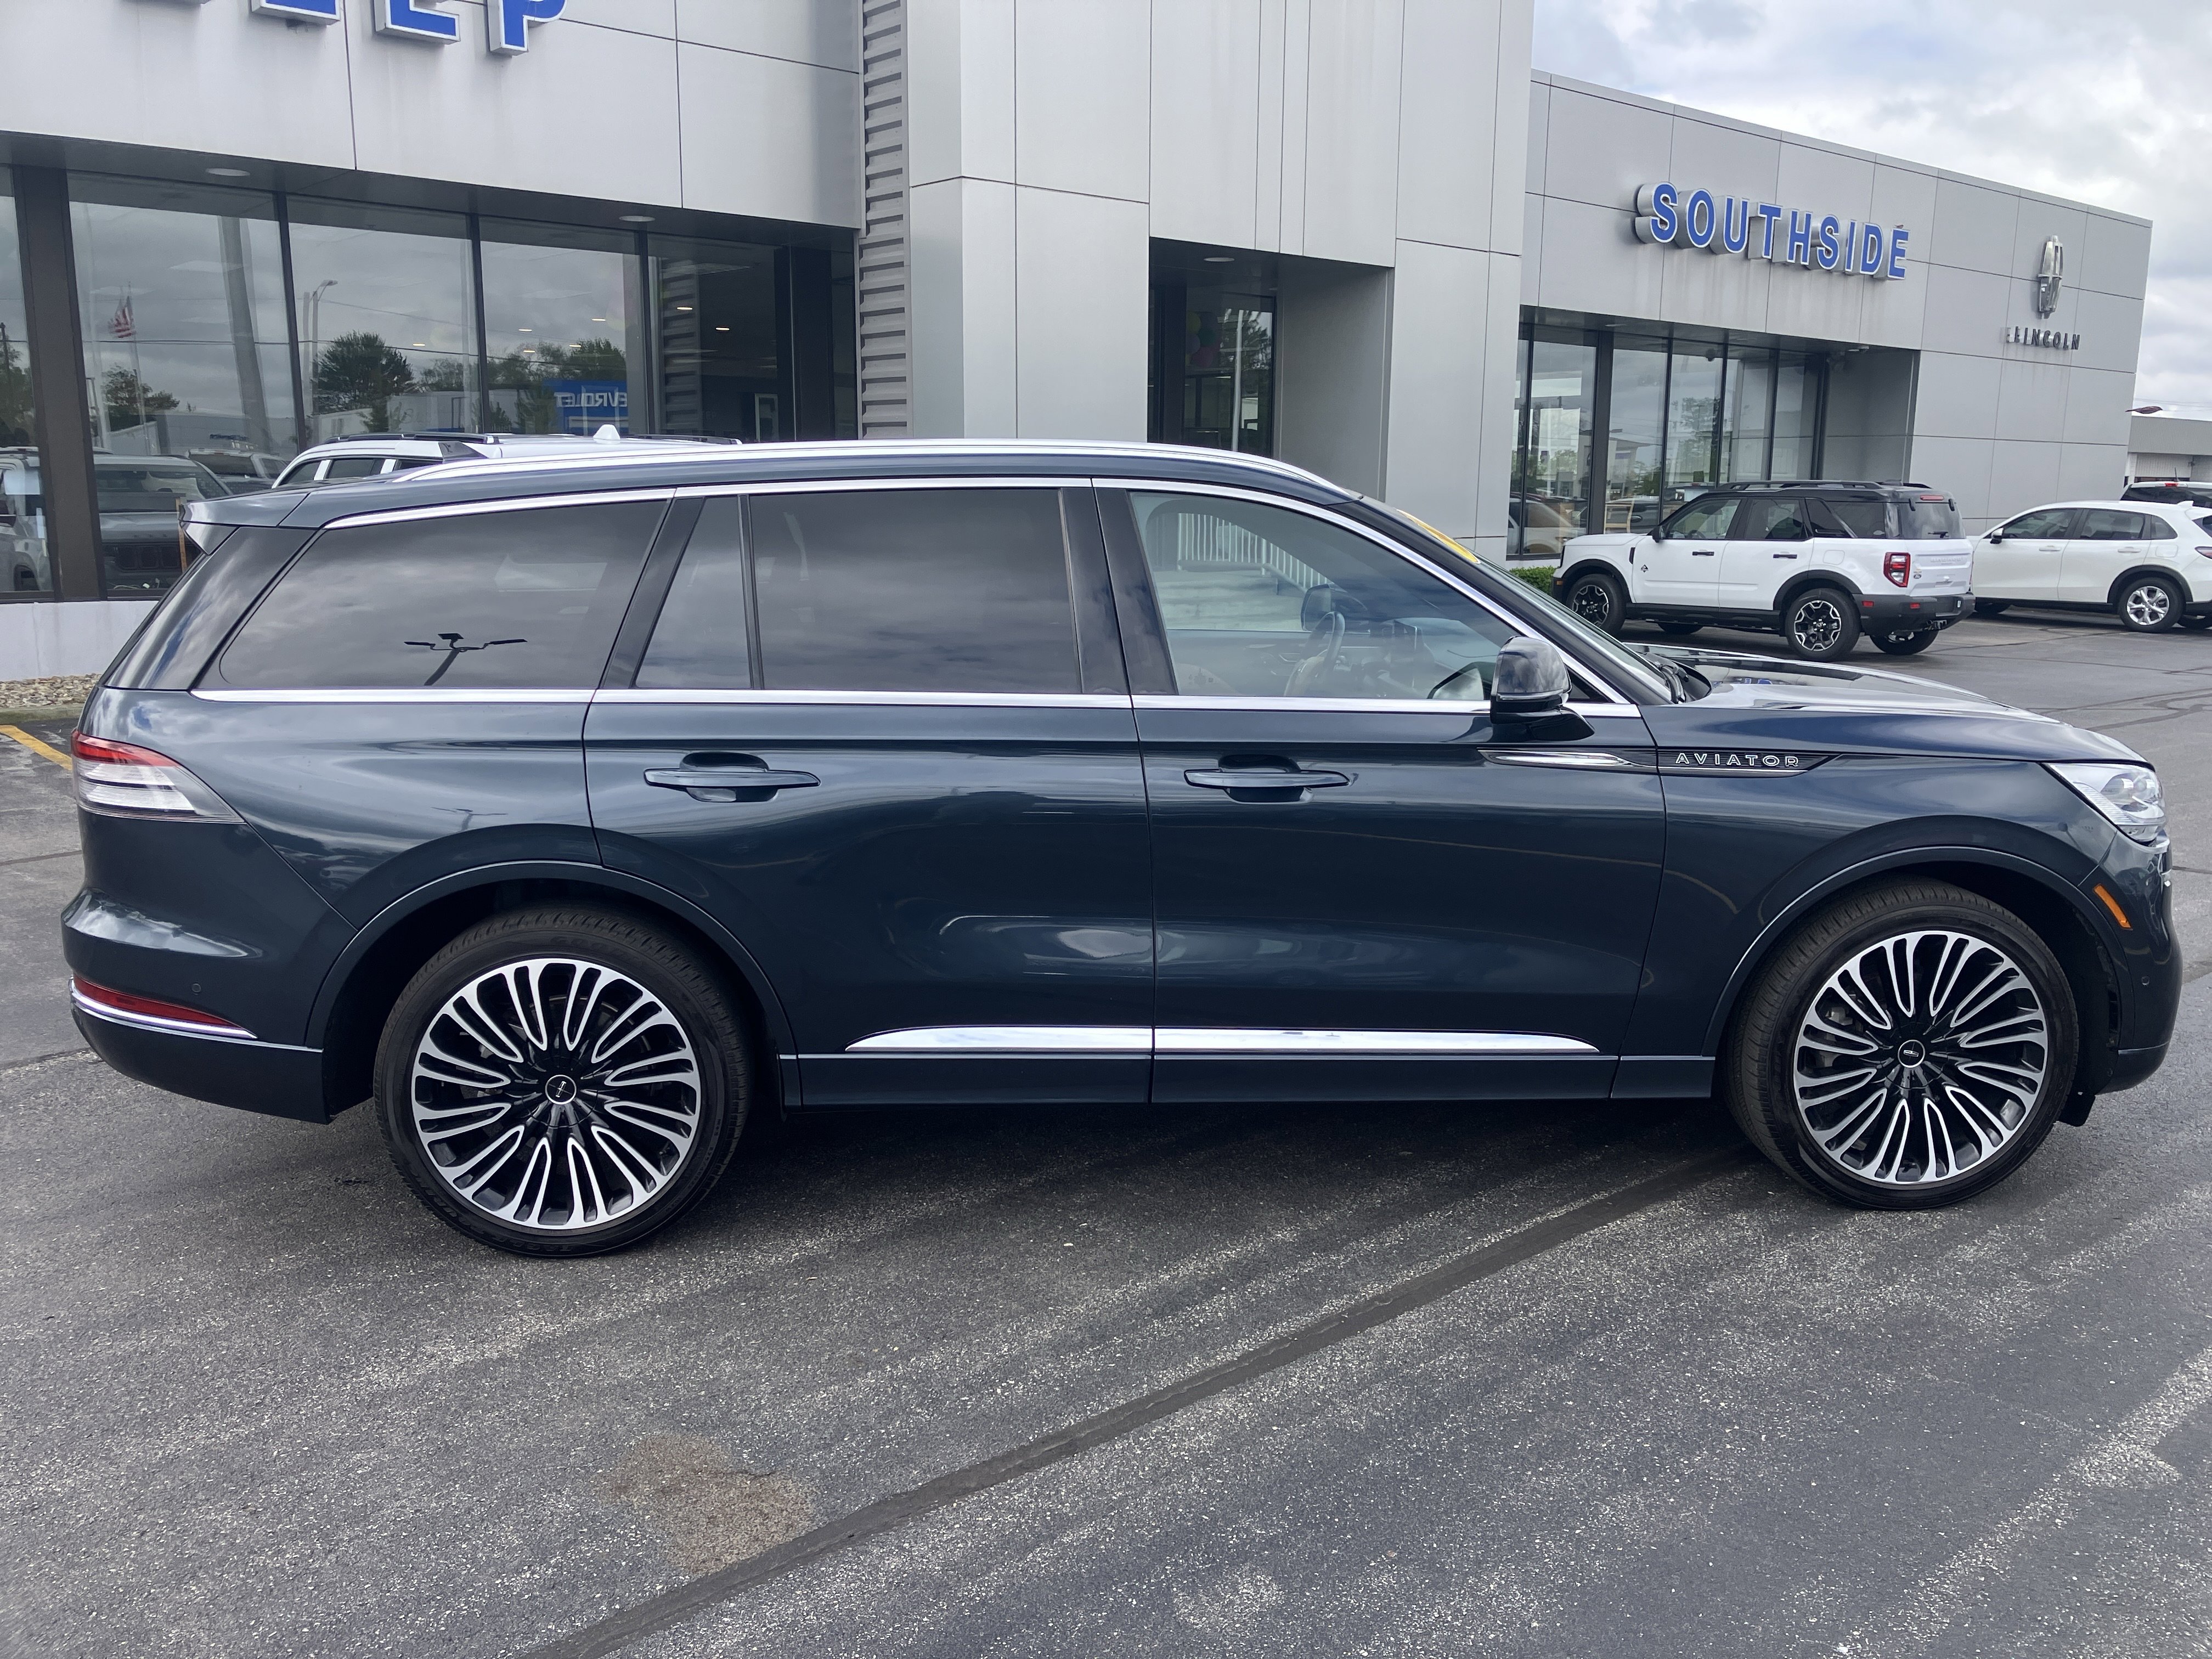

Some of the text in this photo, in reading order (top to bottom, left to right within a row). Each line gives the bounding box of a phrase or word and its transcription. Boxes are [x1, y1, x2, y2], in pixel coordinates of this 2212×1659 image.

[1646, 181, 1910, 280] SOUTHSIDE
[2012, 326, 2080, 350] LINCOLN
[1675, 753, 1799, 768] AVIATOR
